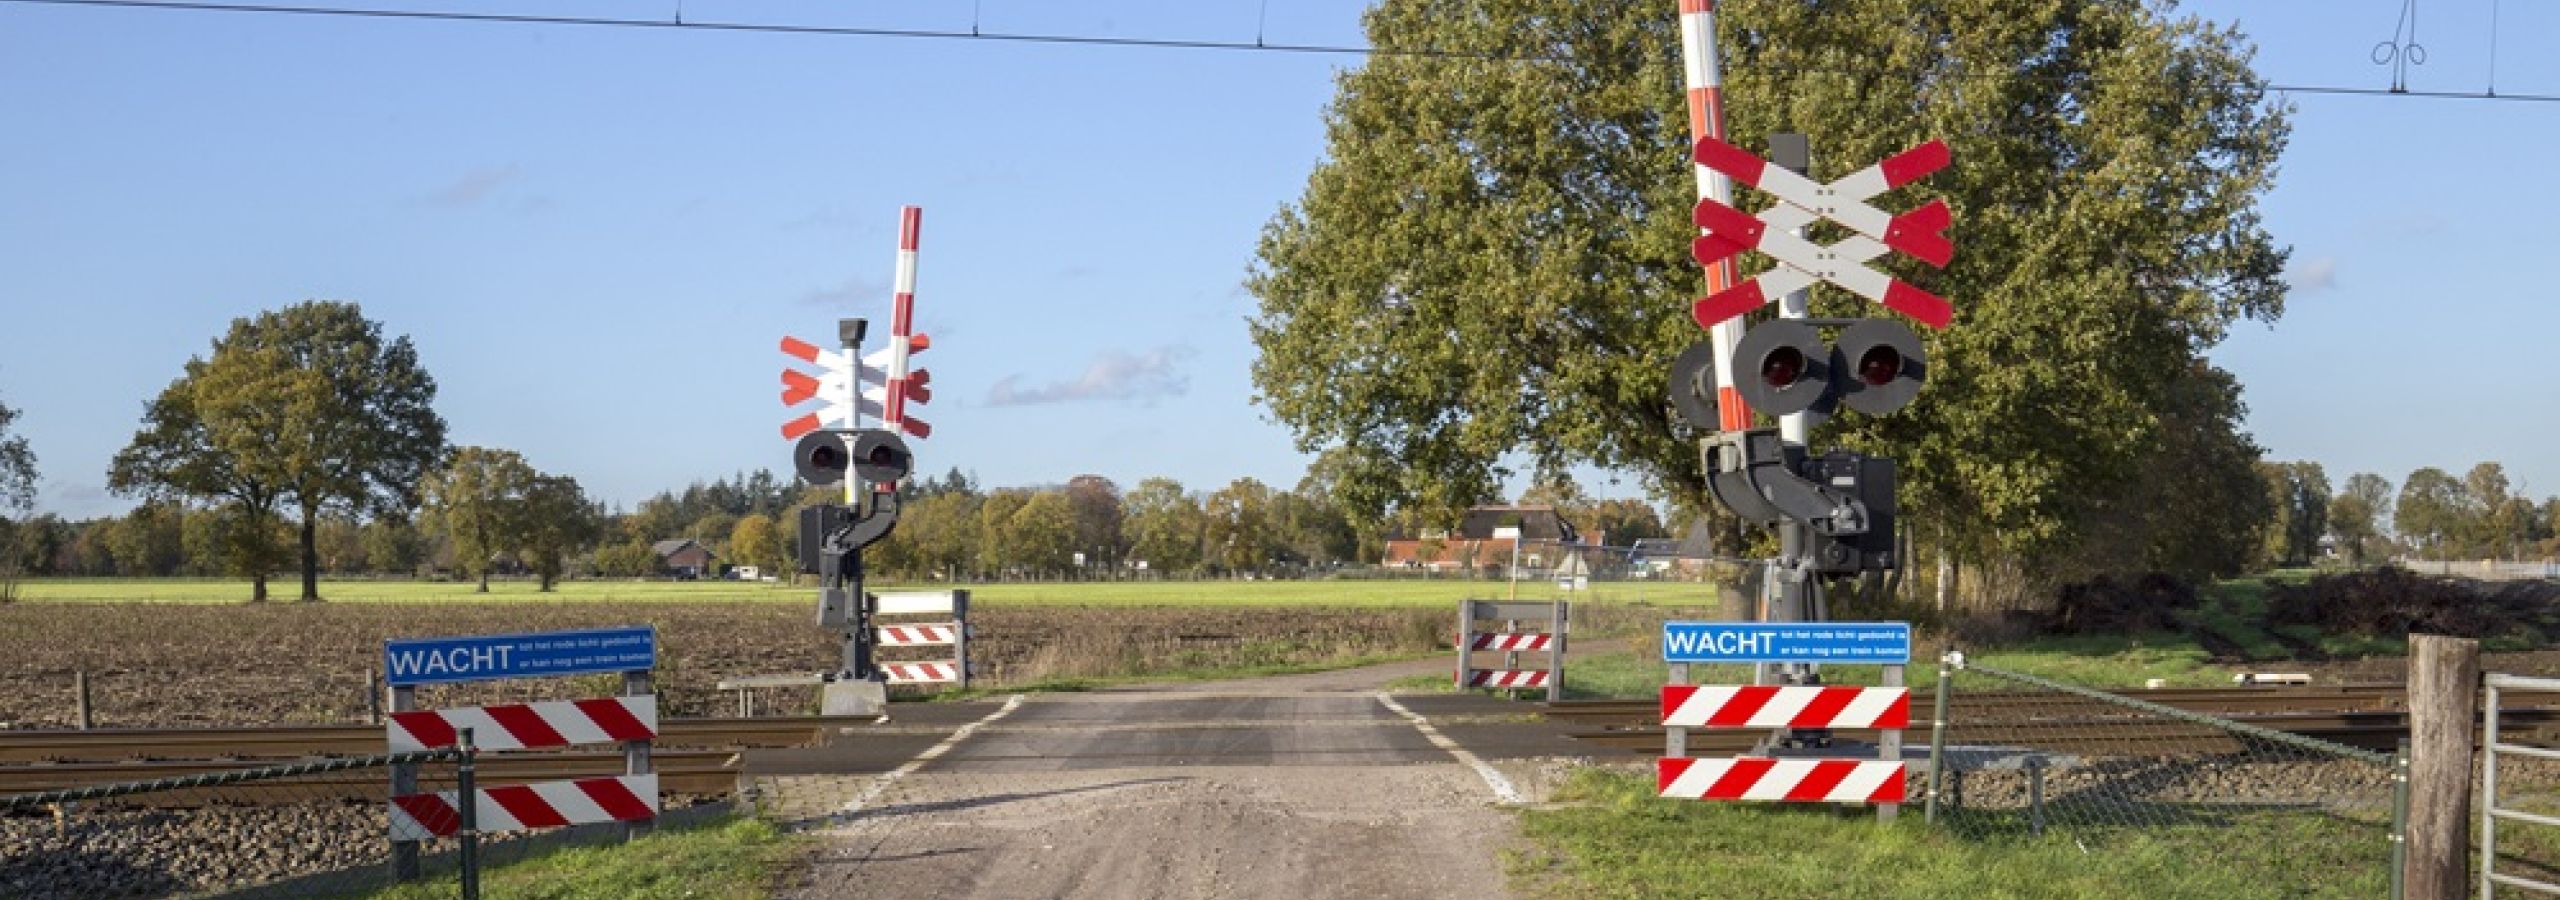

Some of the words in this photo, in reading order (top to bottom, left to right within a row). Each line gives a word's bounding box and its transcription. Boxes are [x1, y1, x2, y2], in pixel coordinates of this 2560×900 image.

[1666, 631, 1777, 654] WACHT
[390, 645, 514, 675] WACHT
[1812, 647, 1829, 657] nog
[552, 657, 572, 668] nog
